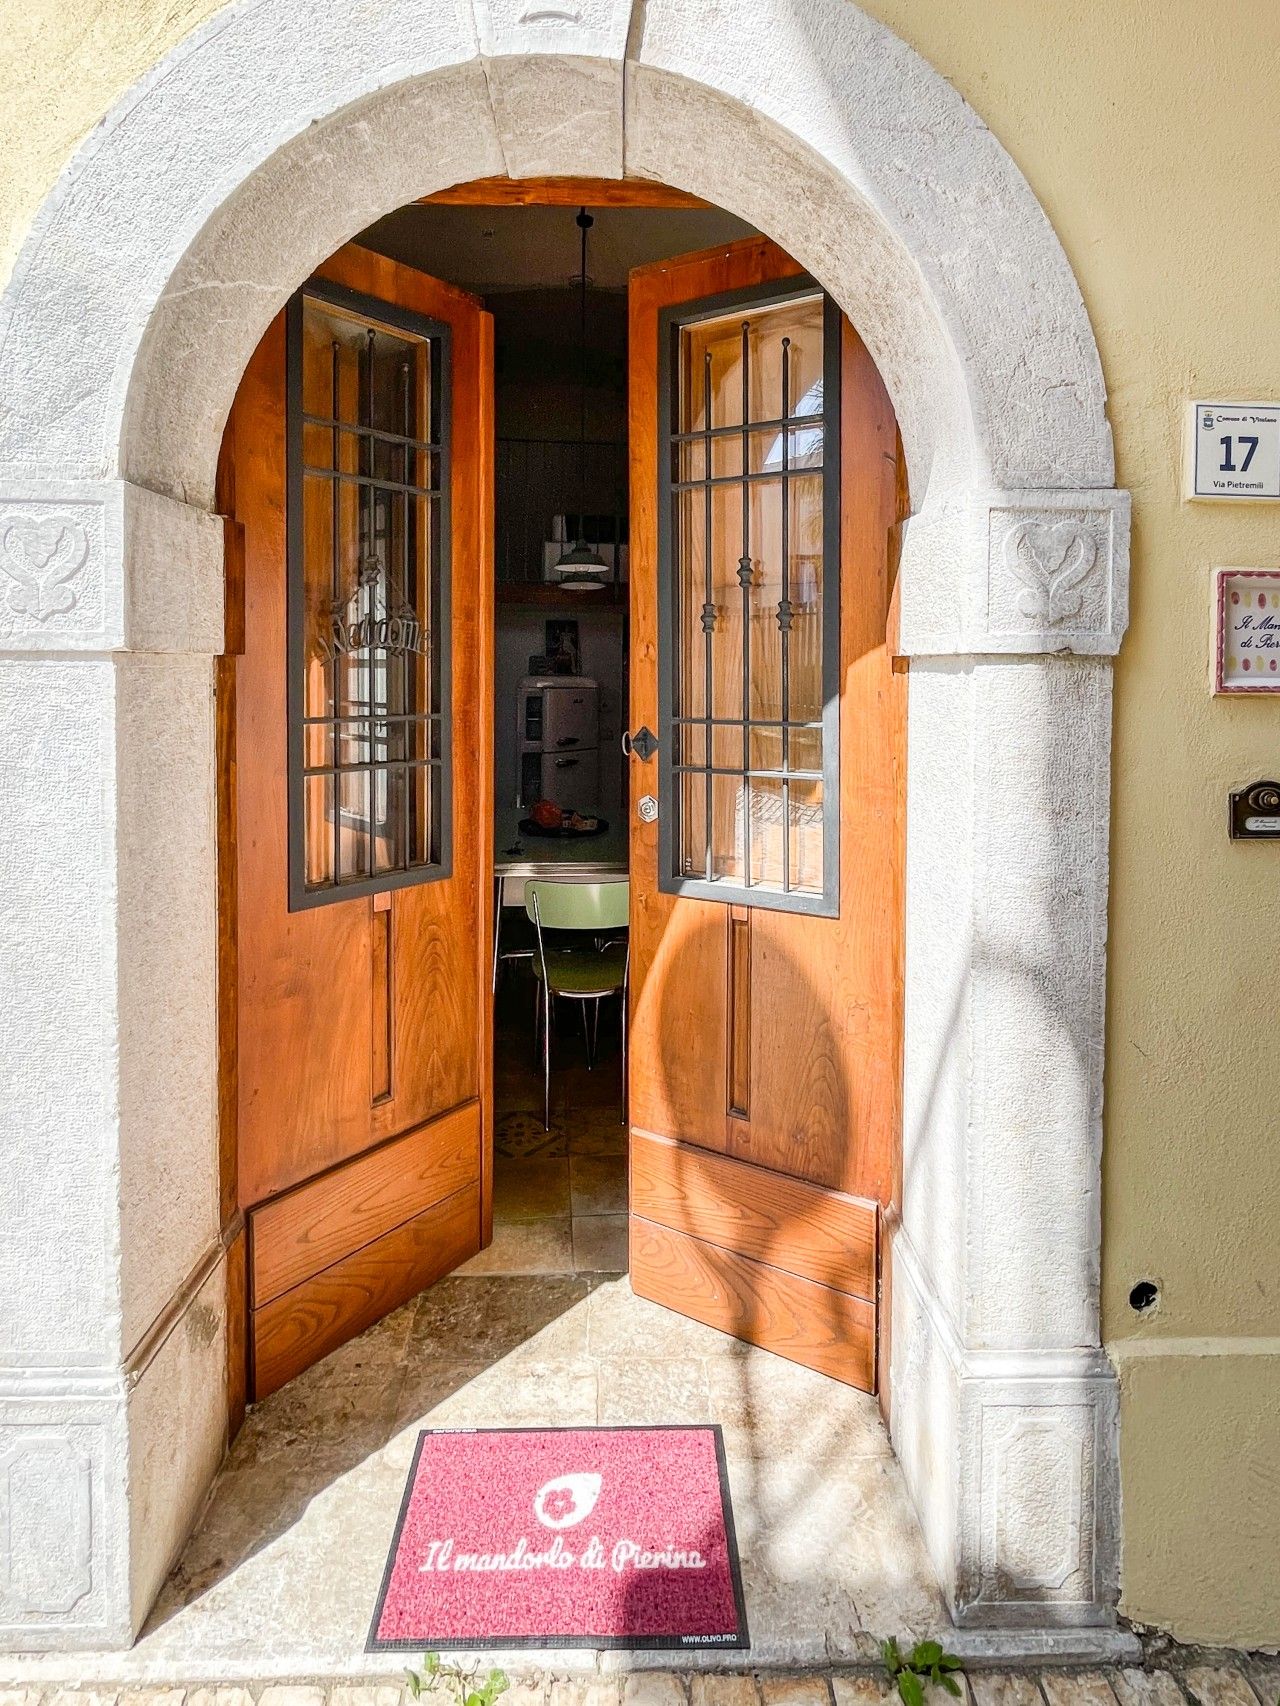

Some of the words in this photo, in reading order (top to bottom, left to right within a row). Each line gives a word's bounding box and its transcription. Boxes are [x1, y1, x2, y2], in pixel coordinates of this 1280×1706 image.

[1220, 435, 1259, 472] 17
[1213, 480, 1226, 488] Via
[1234, 615, 1253, 630] Il
[1240, 635, 1253, 648] di
[419, 1539, 453, 1571] Il
[454, 1535, 575, 1571] mandorlo
[580, 1535, 606, 1568] di
[612, 1539, 706, 1572] Pierina
[681, 1634, 737, 1644] WWW.OLIVO.PRO
